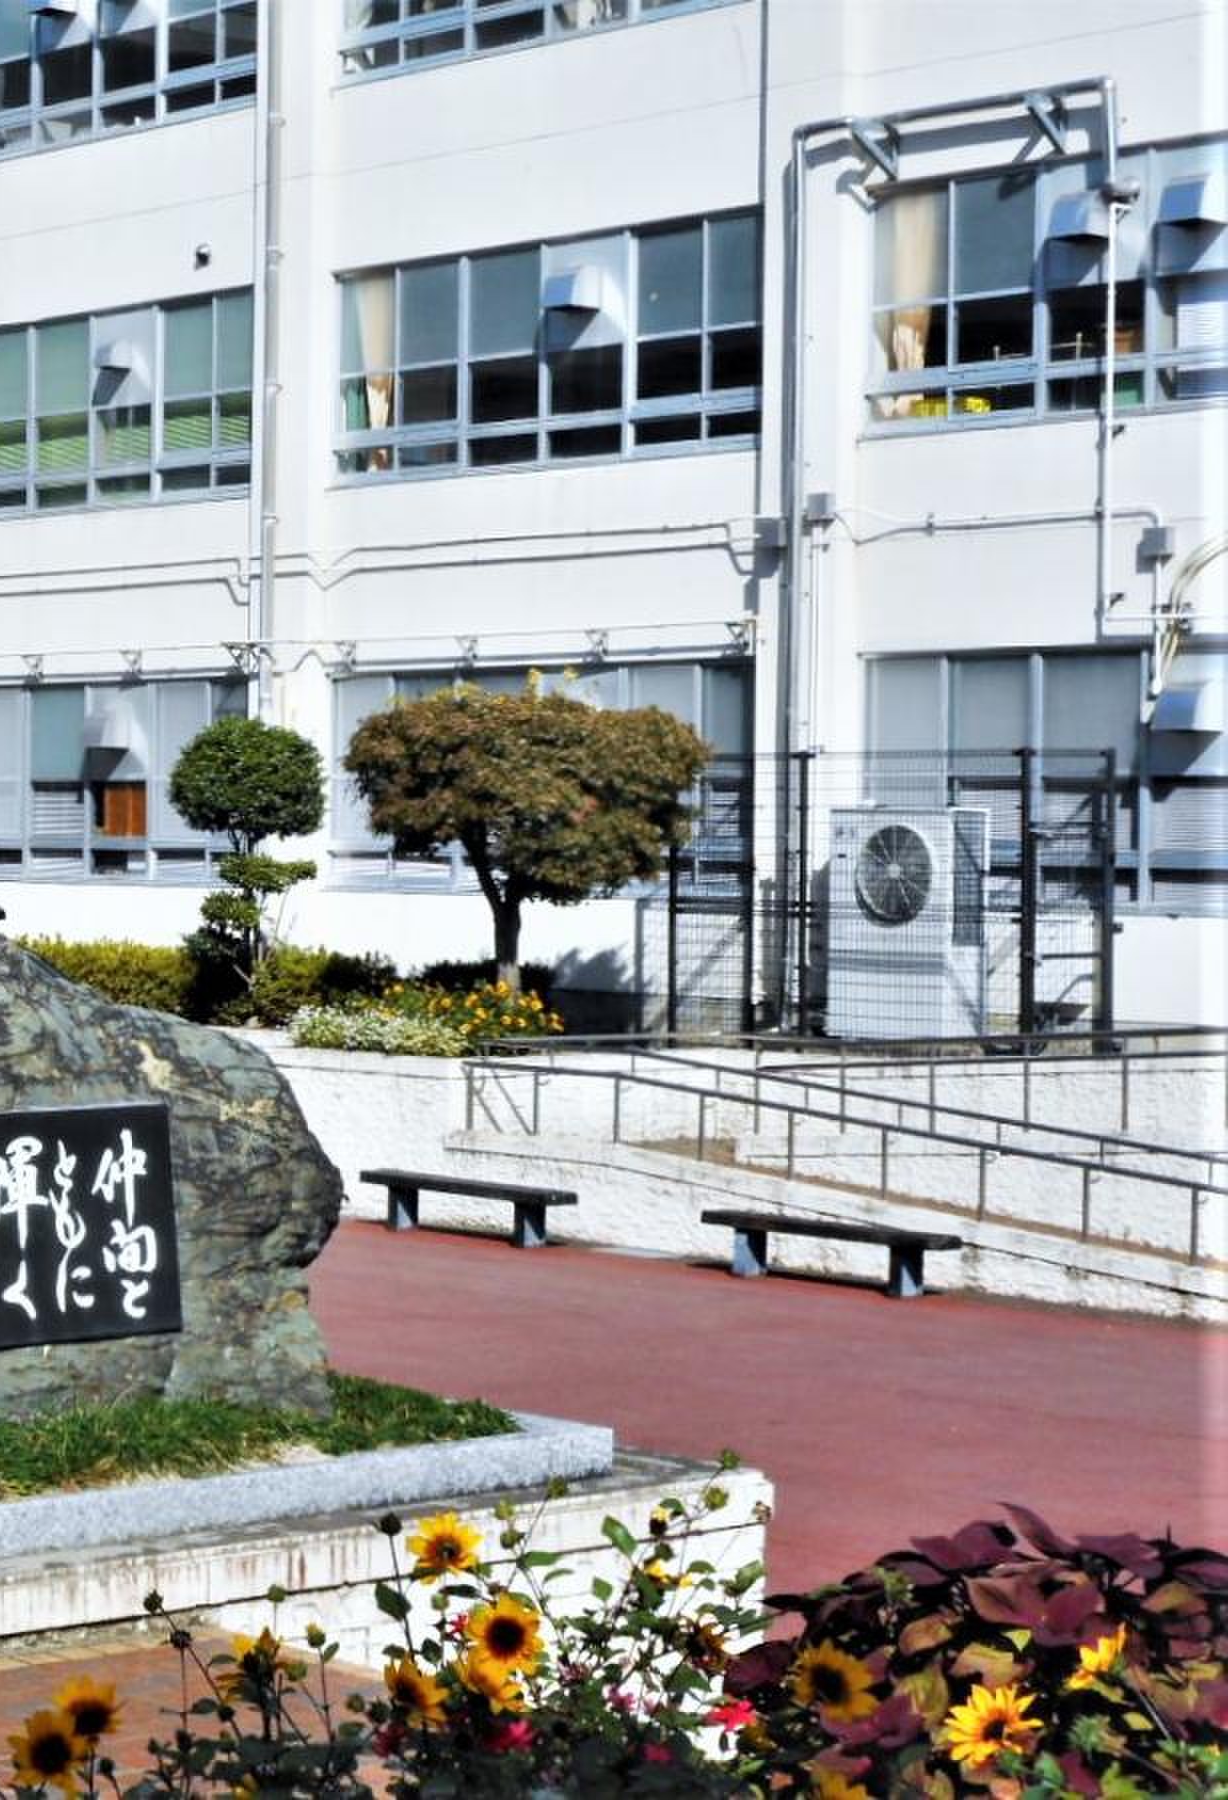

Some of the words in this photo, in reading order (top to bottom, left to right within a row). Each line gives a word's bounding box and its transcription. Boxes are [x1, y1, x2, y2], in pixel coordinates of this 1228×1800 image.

[49, 1139, 94, 1313] ともに
[91, 1129, 157, 1319] 仲間と
